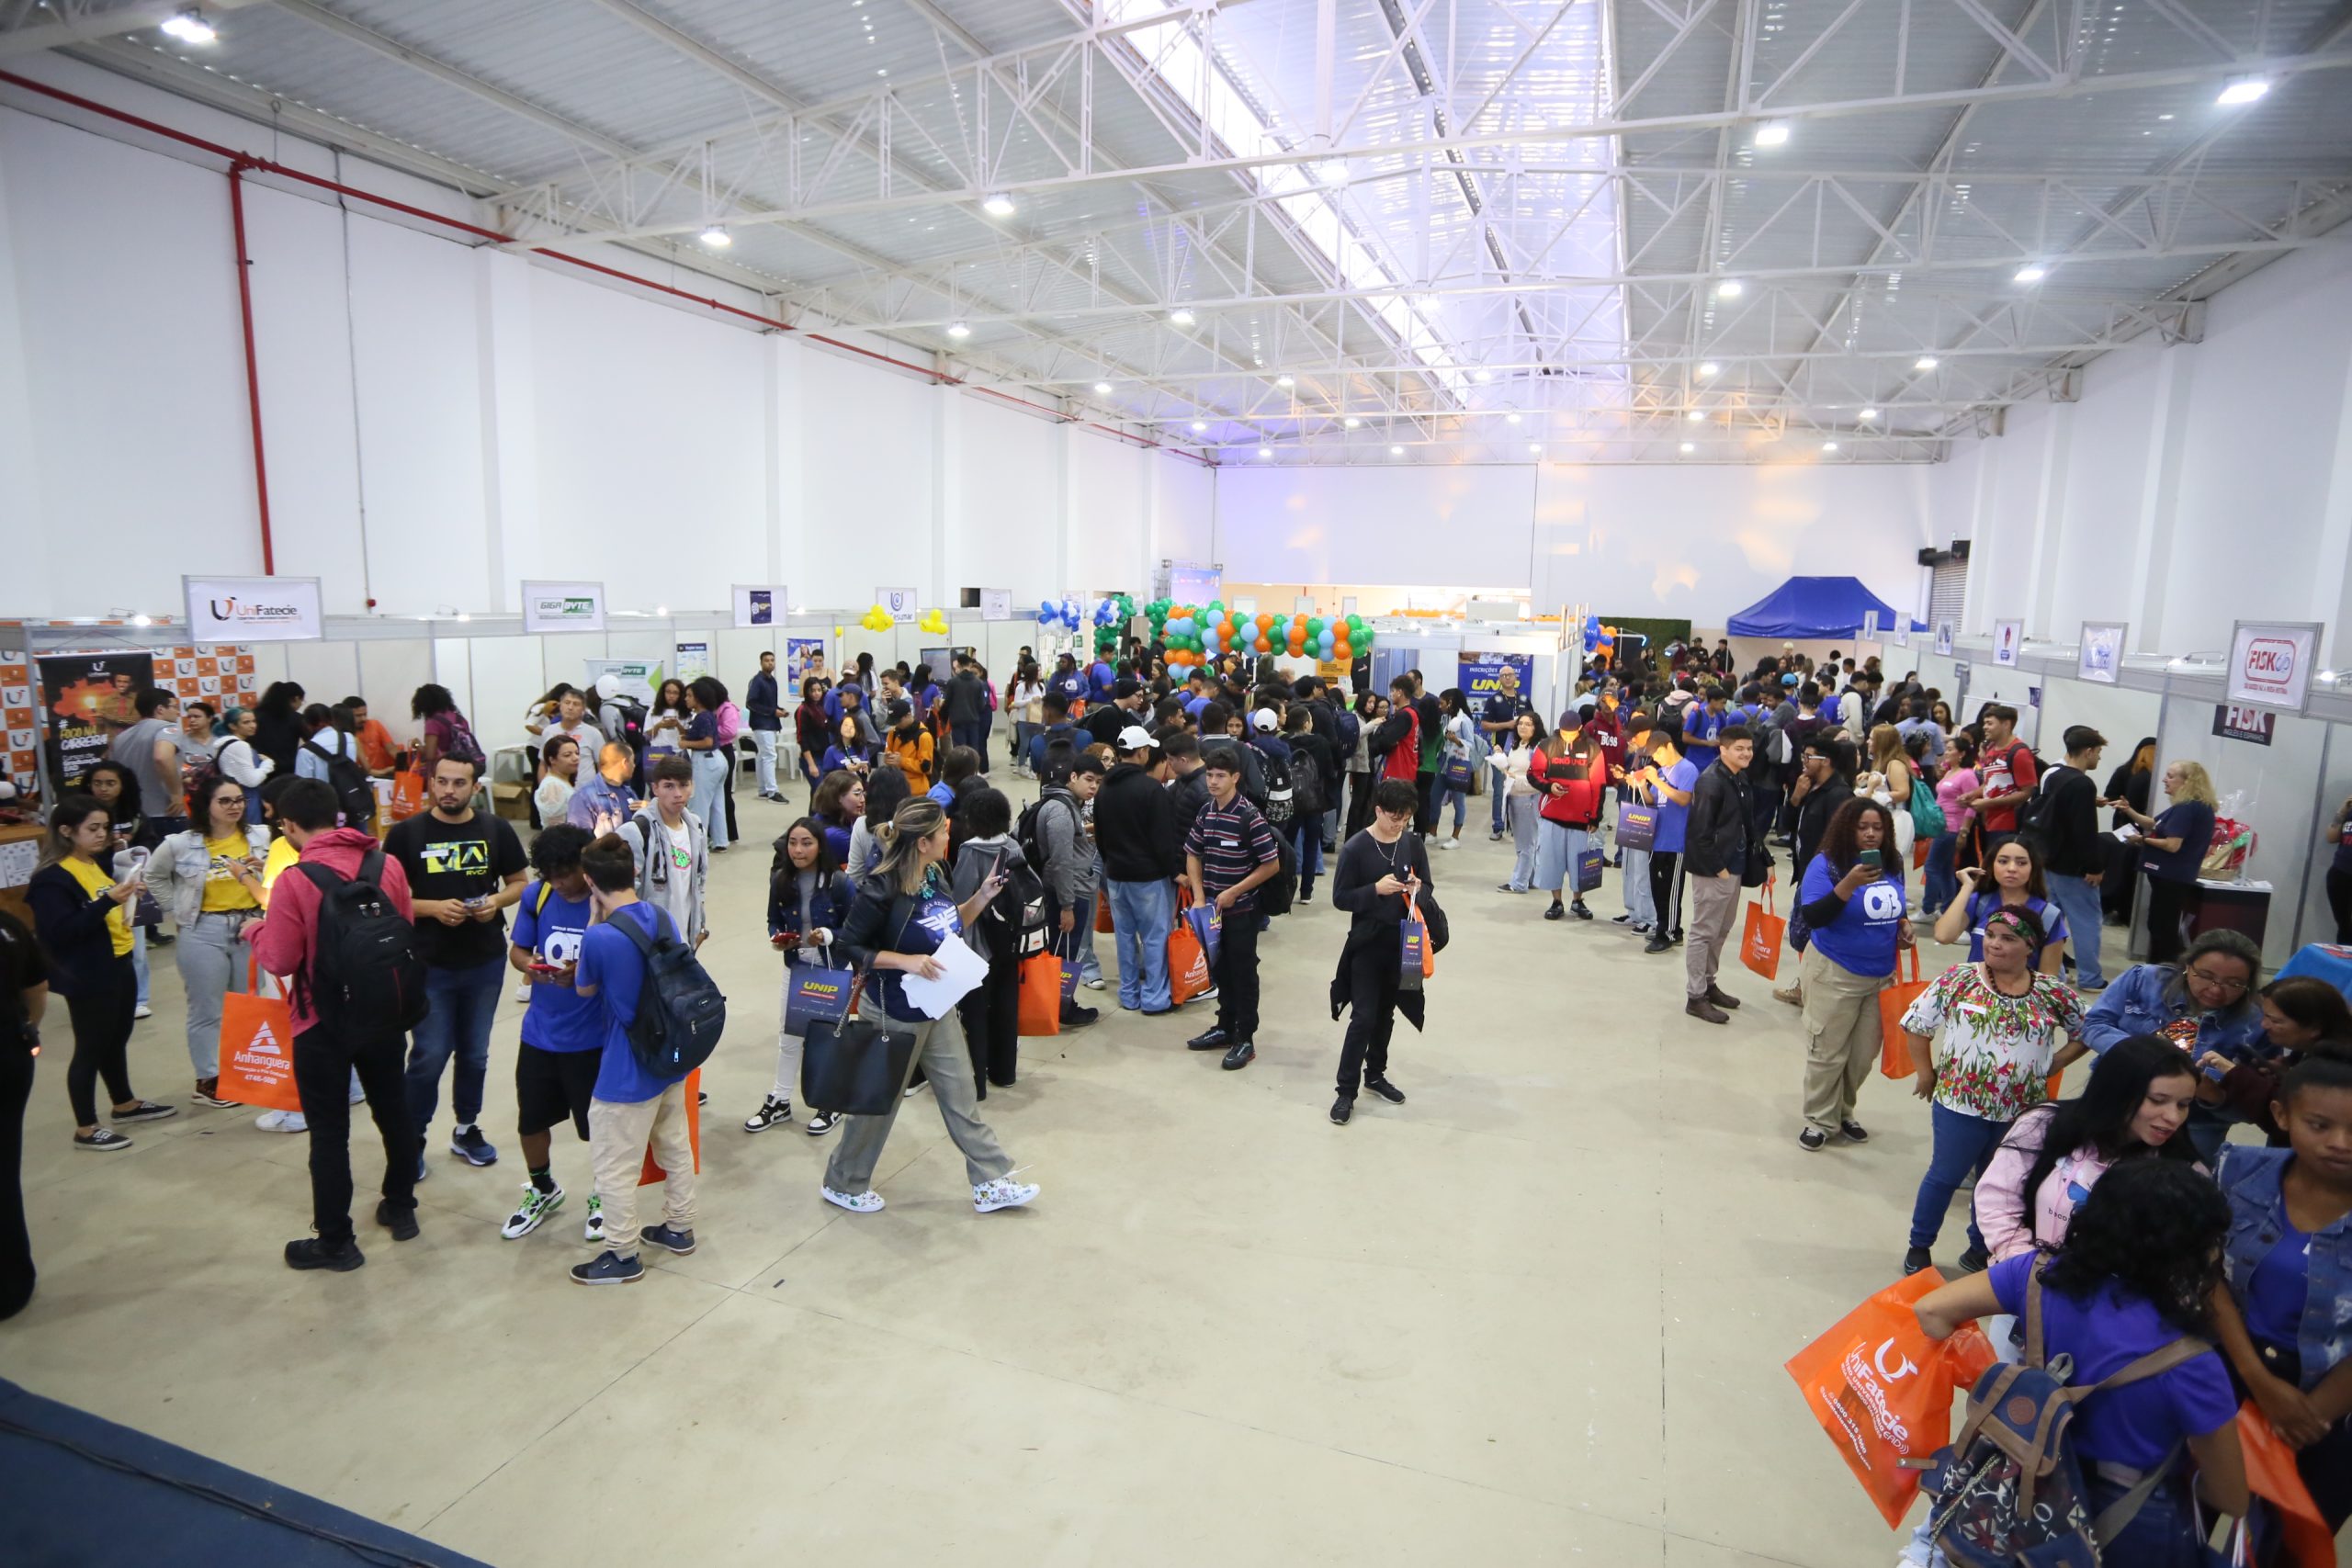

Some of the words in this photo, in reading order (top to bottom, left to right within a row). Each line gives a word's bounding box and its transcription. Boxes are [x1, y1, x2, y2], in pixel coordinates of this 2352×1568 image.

[236, 604, 298, 616] UniFatecie
[2248, 649, 2278, 672] FISK
[1471, 679, 1521, 691] UNP
[2224, 705, 2267, 734] FISK
[1628, 812, 1651, 822] UNIP
[803, 981, 839, 993] UNIP
[233, 1051, 290, 1070] Anhanguera
[1849, 1341, 1909, 1441] UniFatecie
